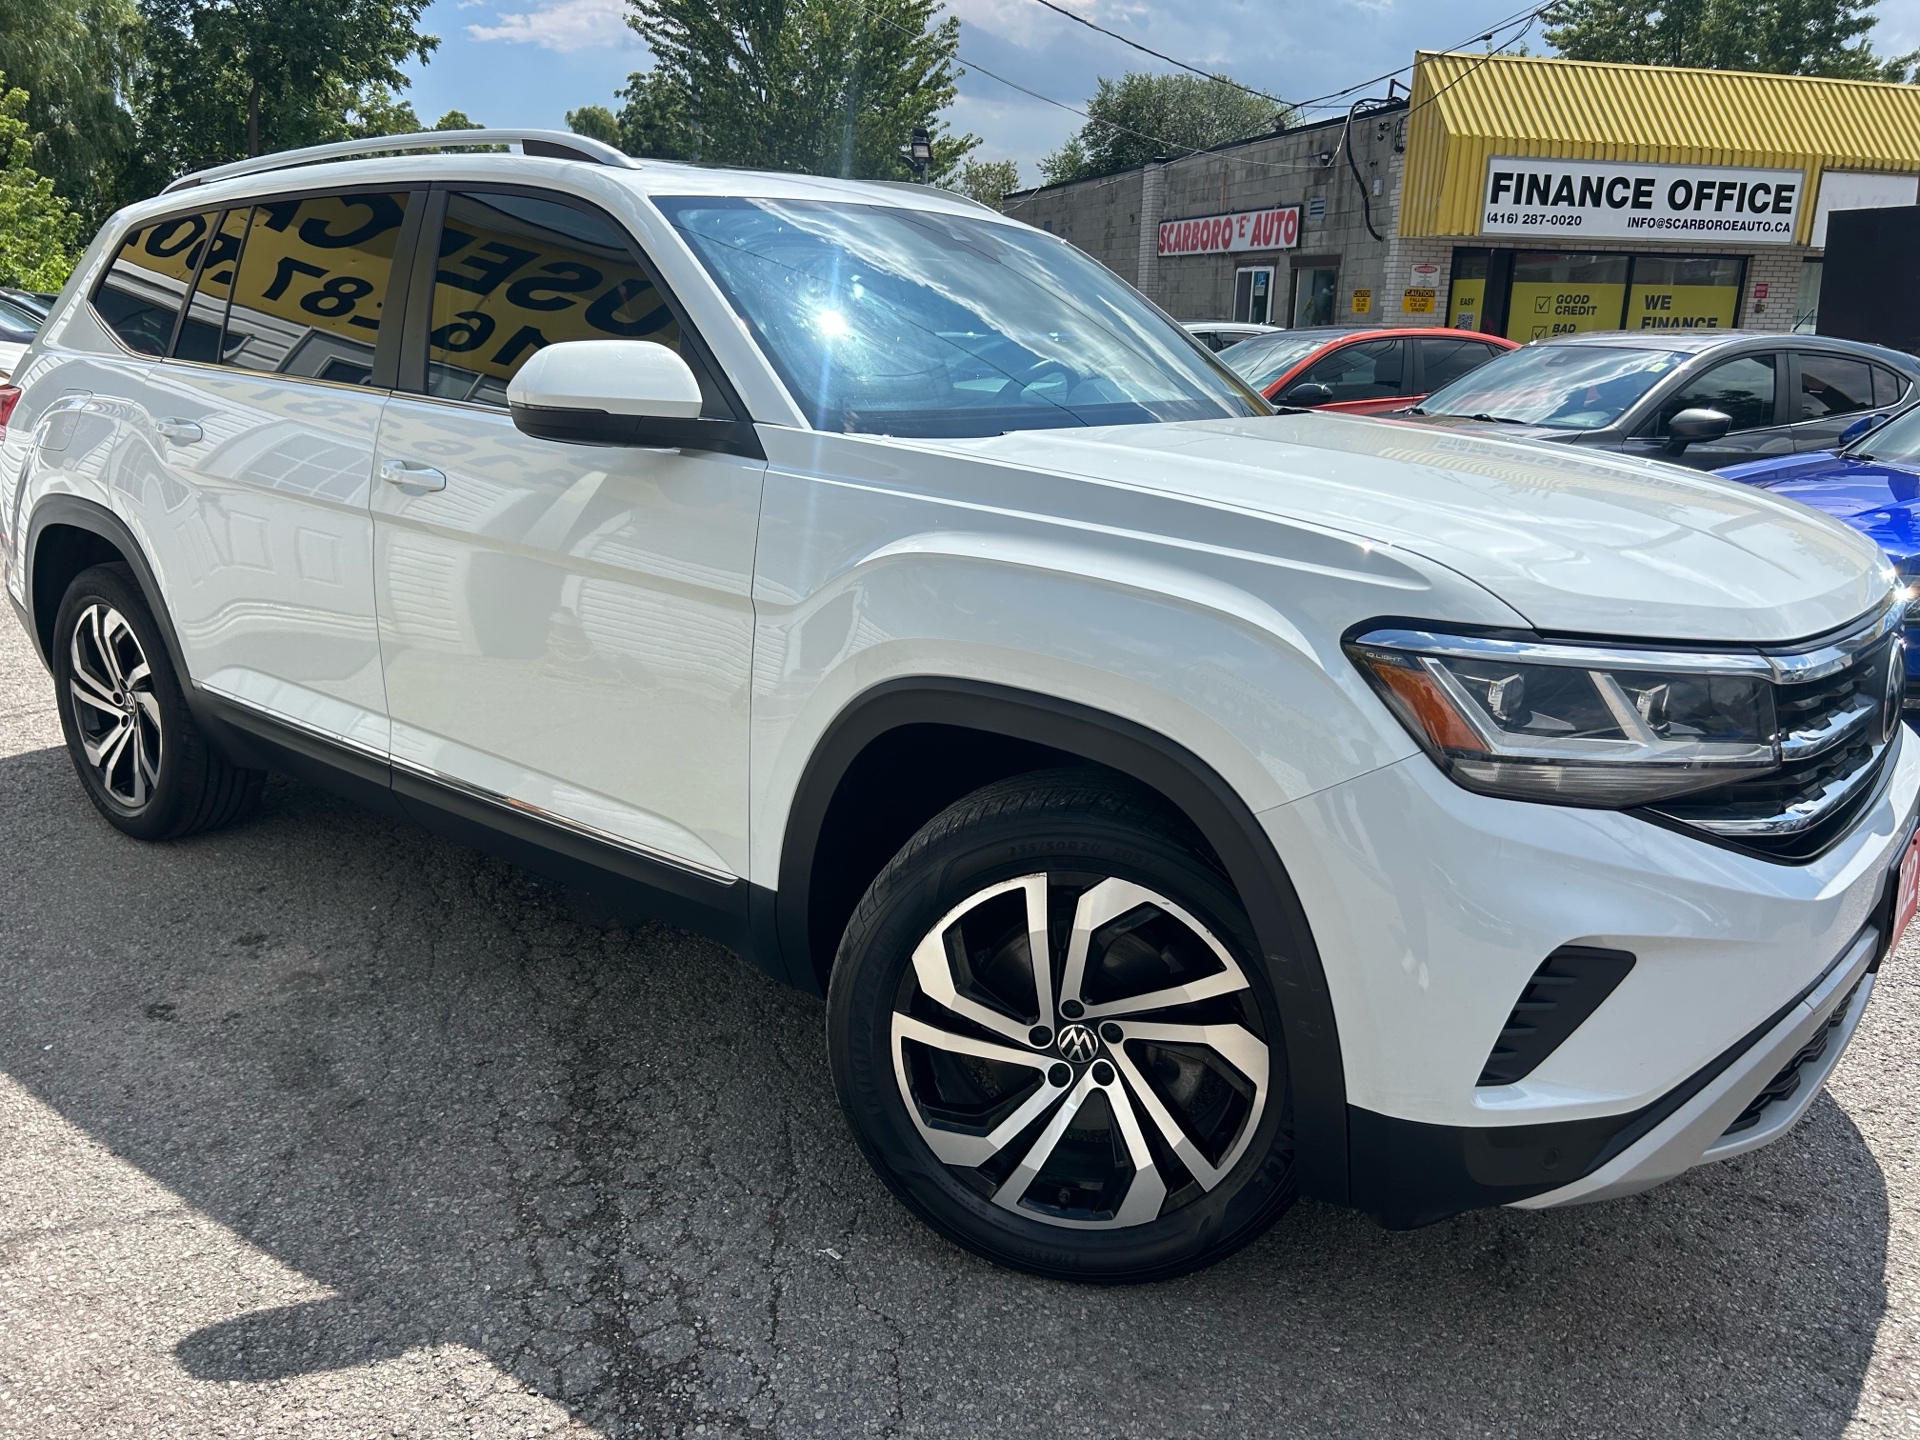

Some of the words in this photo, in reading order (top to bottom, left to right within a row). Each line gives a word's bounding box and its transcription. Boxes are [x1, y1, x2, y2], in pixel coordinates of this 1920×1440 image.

[1490, 172, 1655, 209] FINANCE
[1667, 179, 1796, 215] OFFICE
[1487, 212, 1518, 224] (416)
[1522, 213, 1582, 226] 287-0020
[1627, 217, 1791, 232] INFO@SCARBOROEAUTO.CA
[1158, 217, 1233, 254] SCARBORO
[1250, 209, 1297, 246] AUTO
[1460, 298, 1475, 306] EASY
[1556, 294, 1590, 305] GOOD
[1645, 295, 1672, 310] WE
[1555, 305, 1597, 316] CREDIT
[1552, 323, 1577, 333] BAD
[1641, 316, 1718, 329] FINANCE
